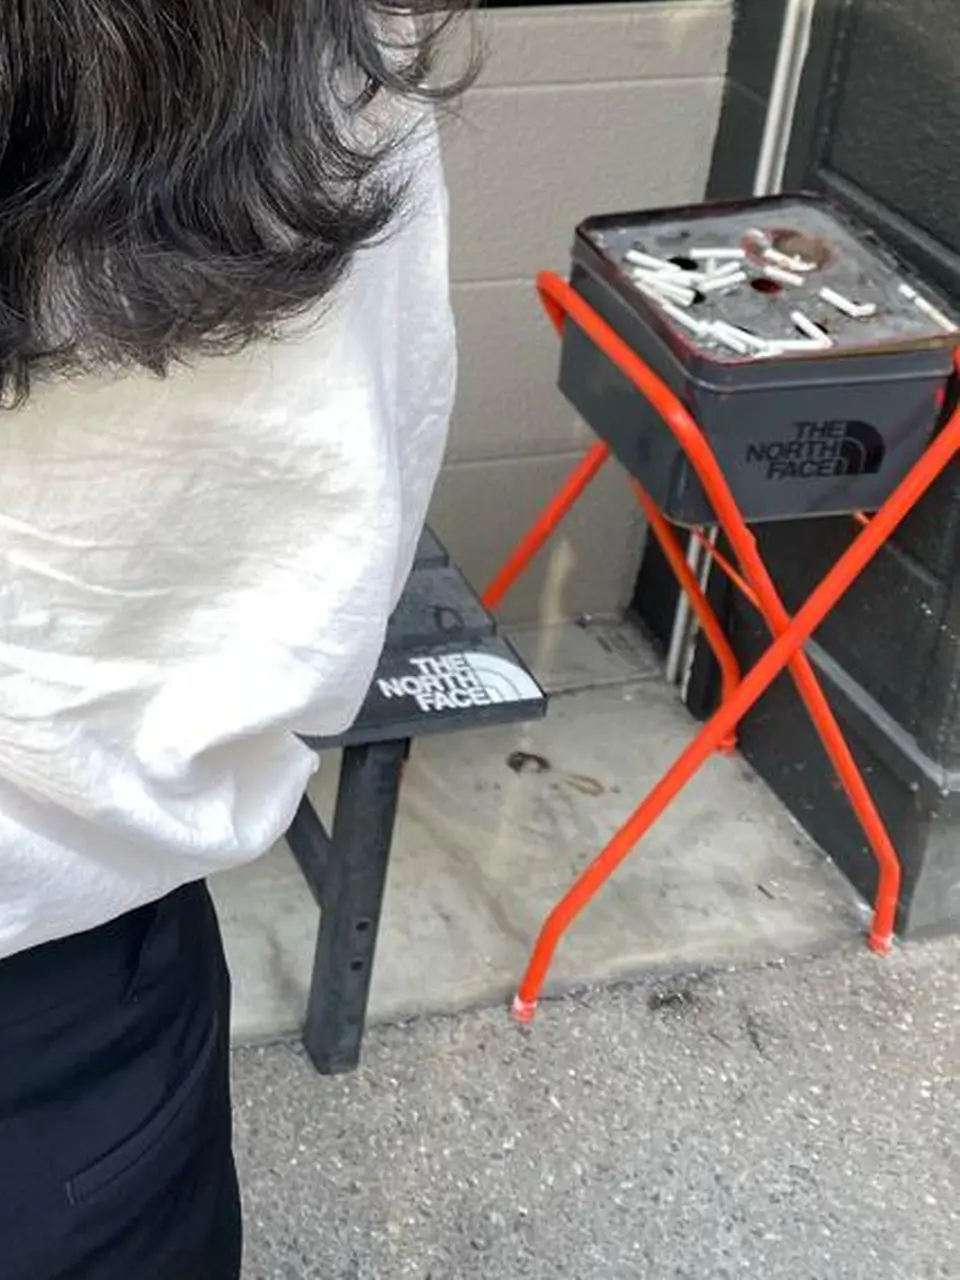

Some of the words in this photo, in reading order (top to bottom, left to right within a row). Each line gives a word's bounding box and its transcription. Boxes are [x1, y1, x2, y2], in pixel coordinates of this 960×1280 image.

[794, 420, 846, 440] THE
[746, 439, 842, 464] NORTH
[767, 460, 837, 480] FACE
[410, 653, 467, 676] THE
[377, 670, 480, 698] NORTH
[415, 688, 488, 712] FACE
